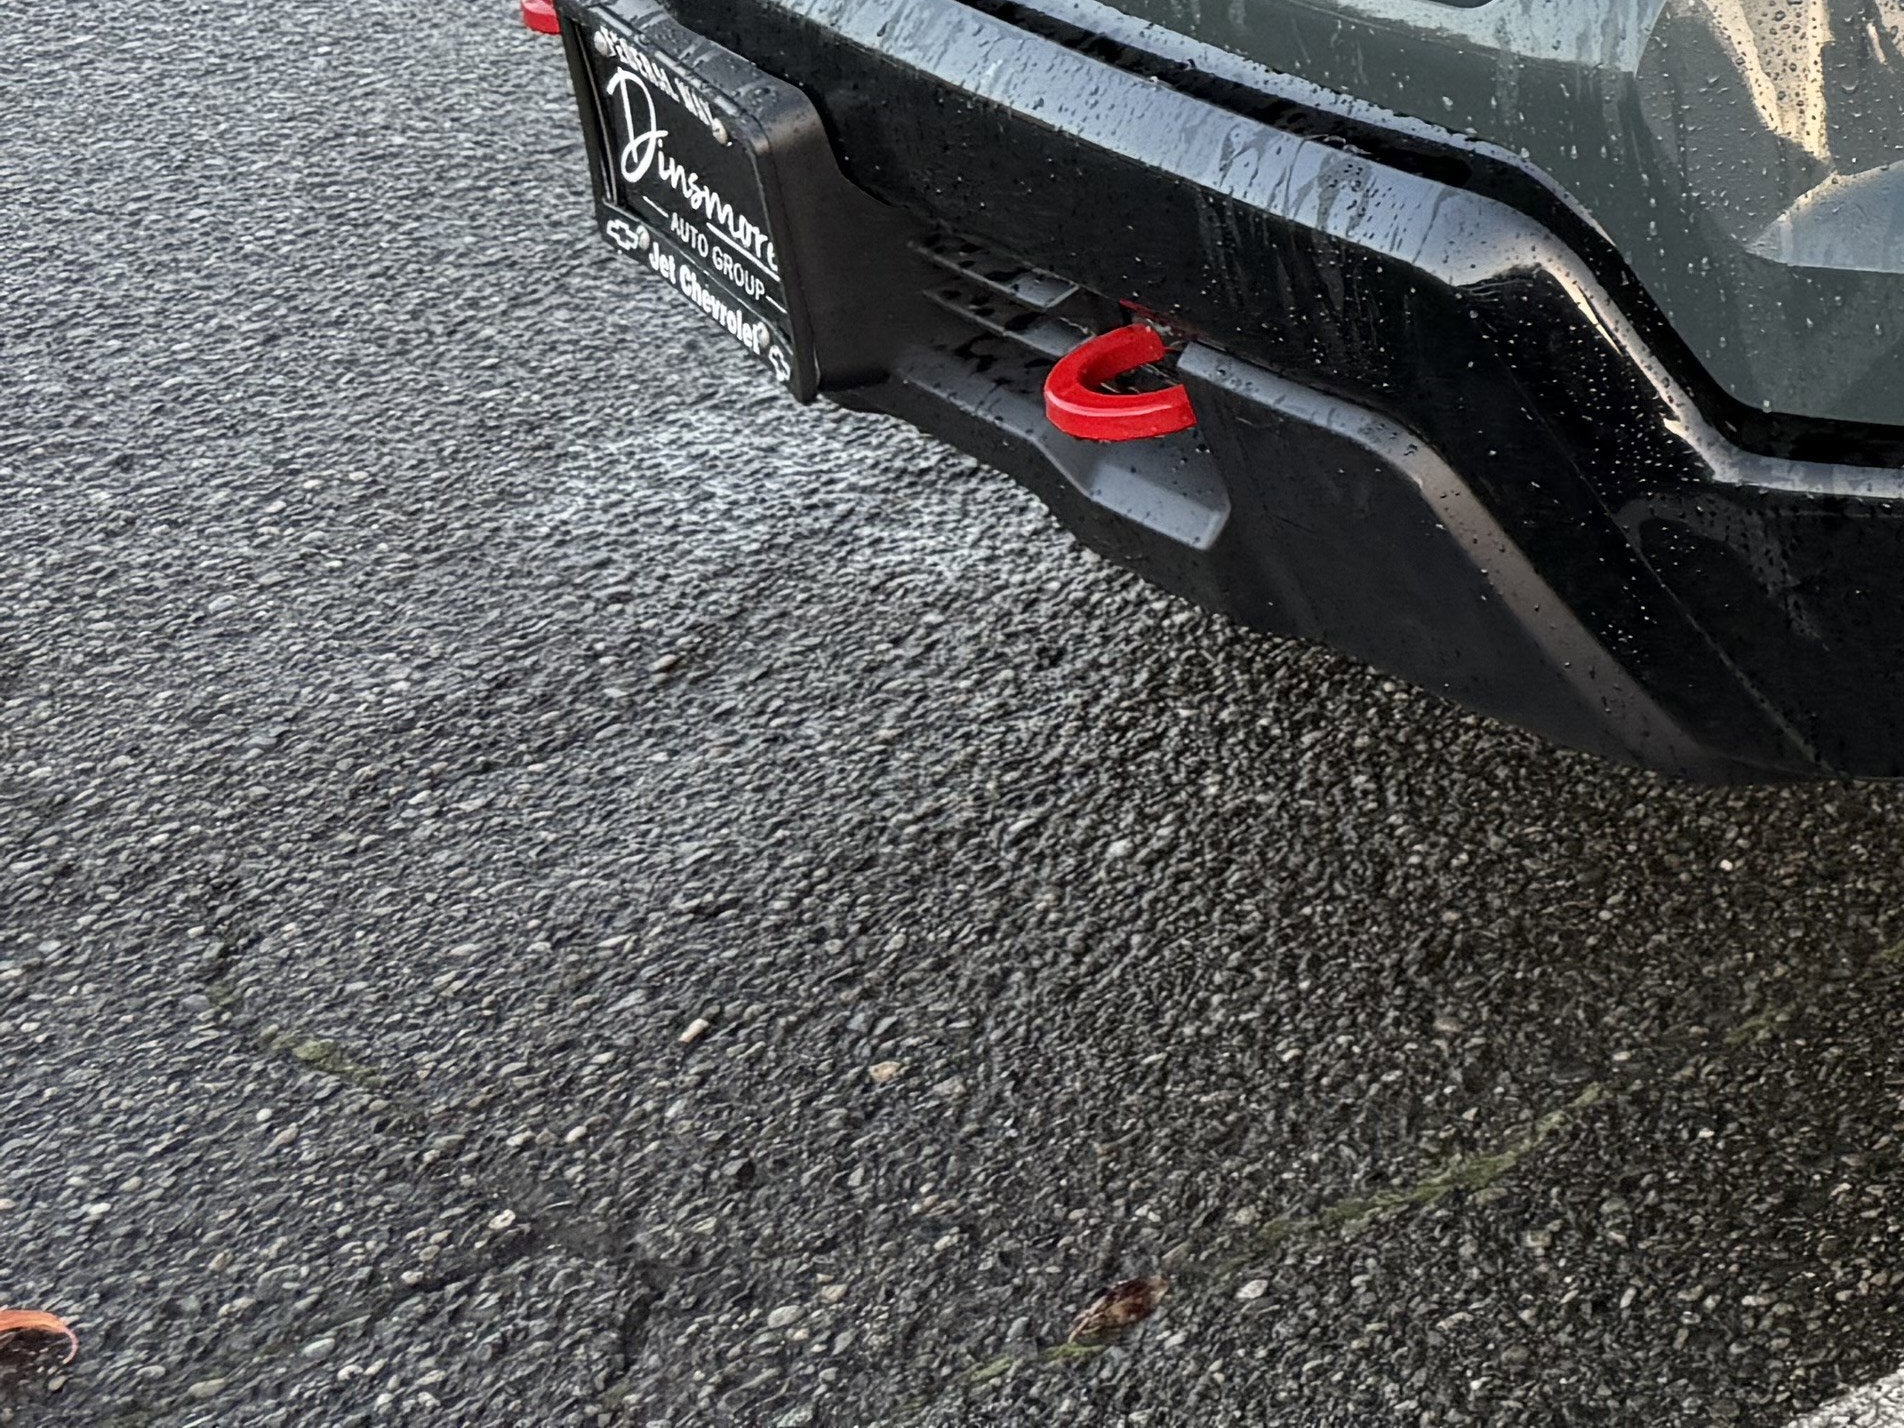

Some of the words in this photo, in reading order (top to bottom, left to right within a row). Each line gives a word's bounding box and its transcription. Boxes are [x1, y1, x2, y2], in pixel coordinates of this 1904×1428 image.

[648, 240, 677, 286] Jet
[678, 262, 762, 356] Chevrolet
[670, 211, 708, 258] AUTO
[711, 245, 765, 301] GROUP
